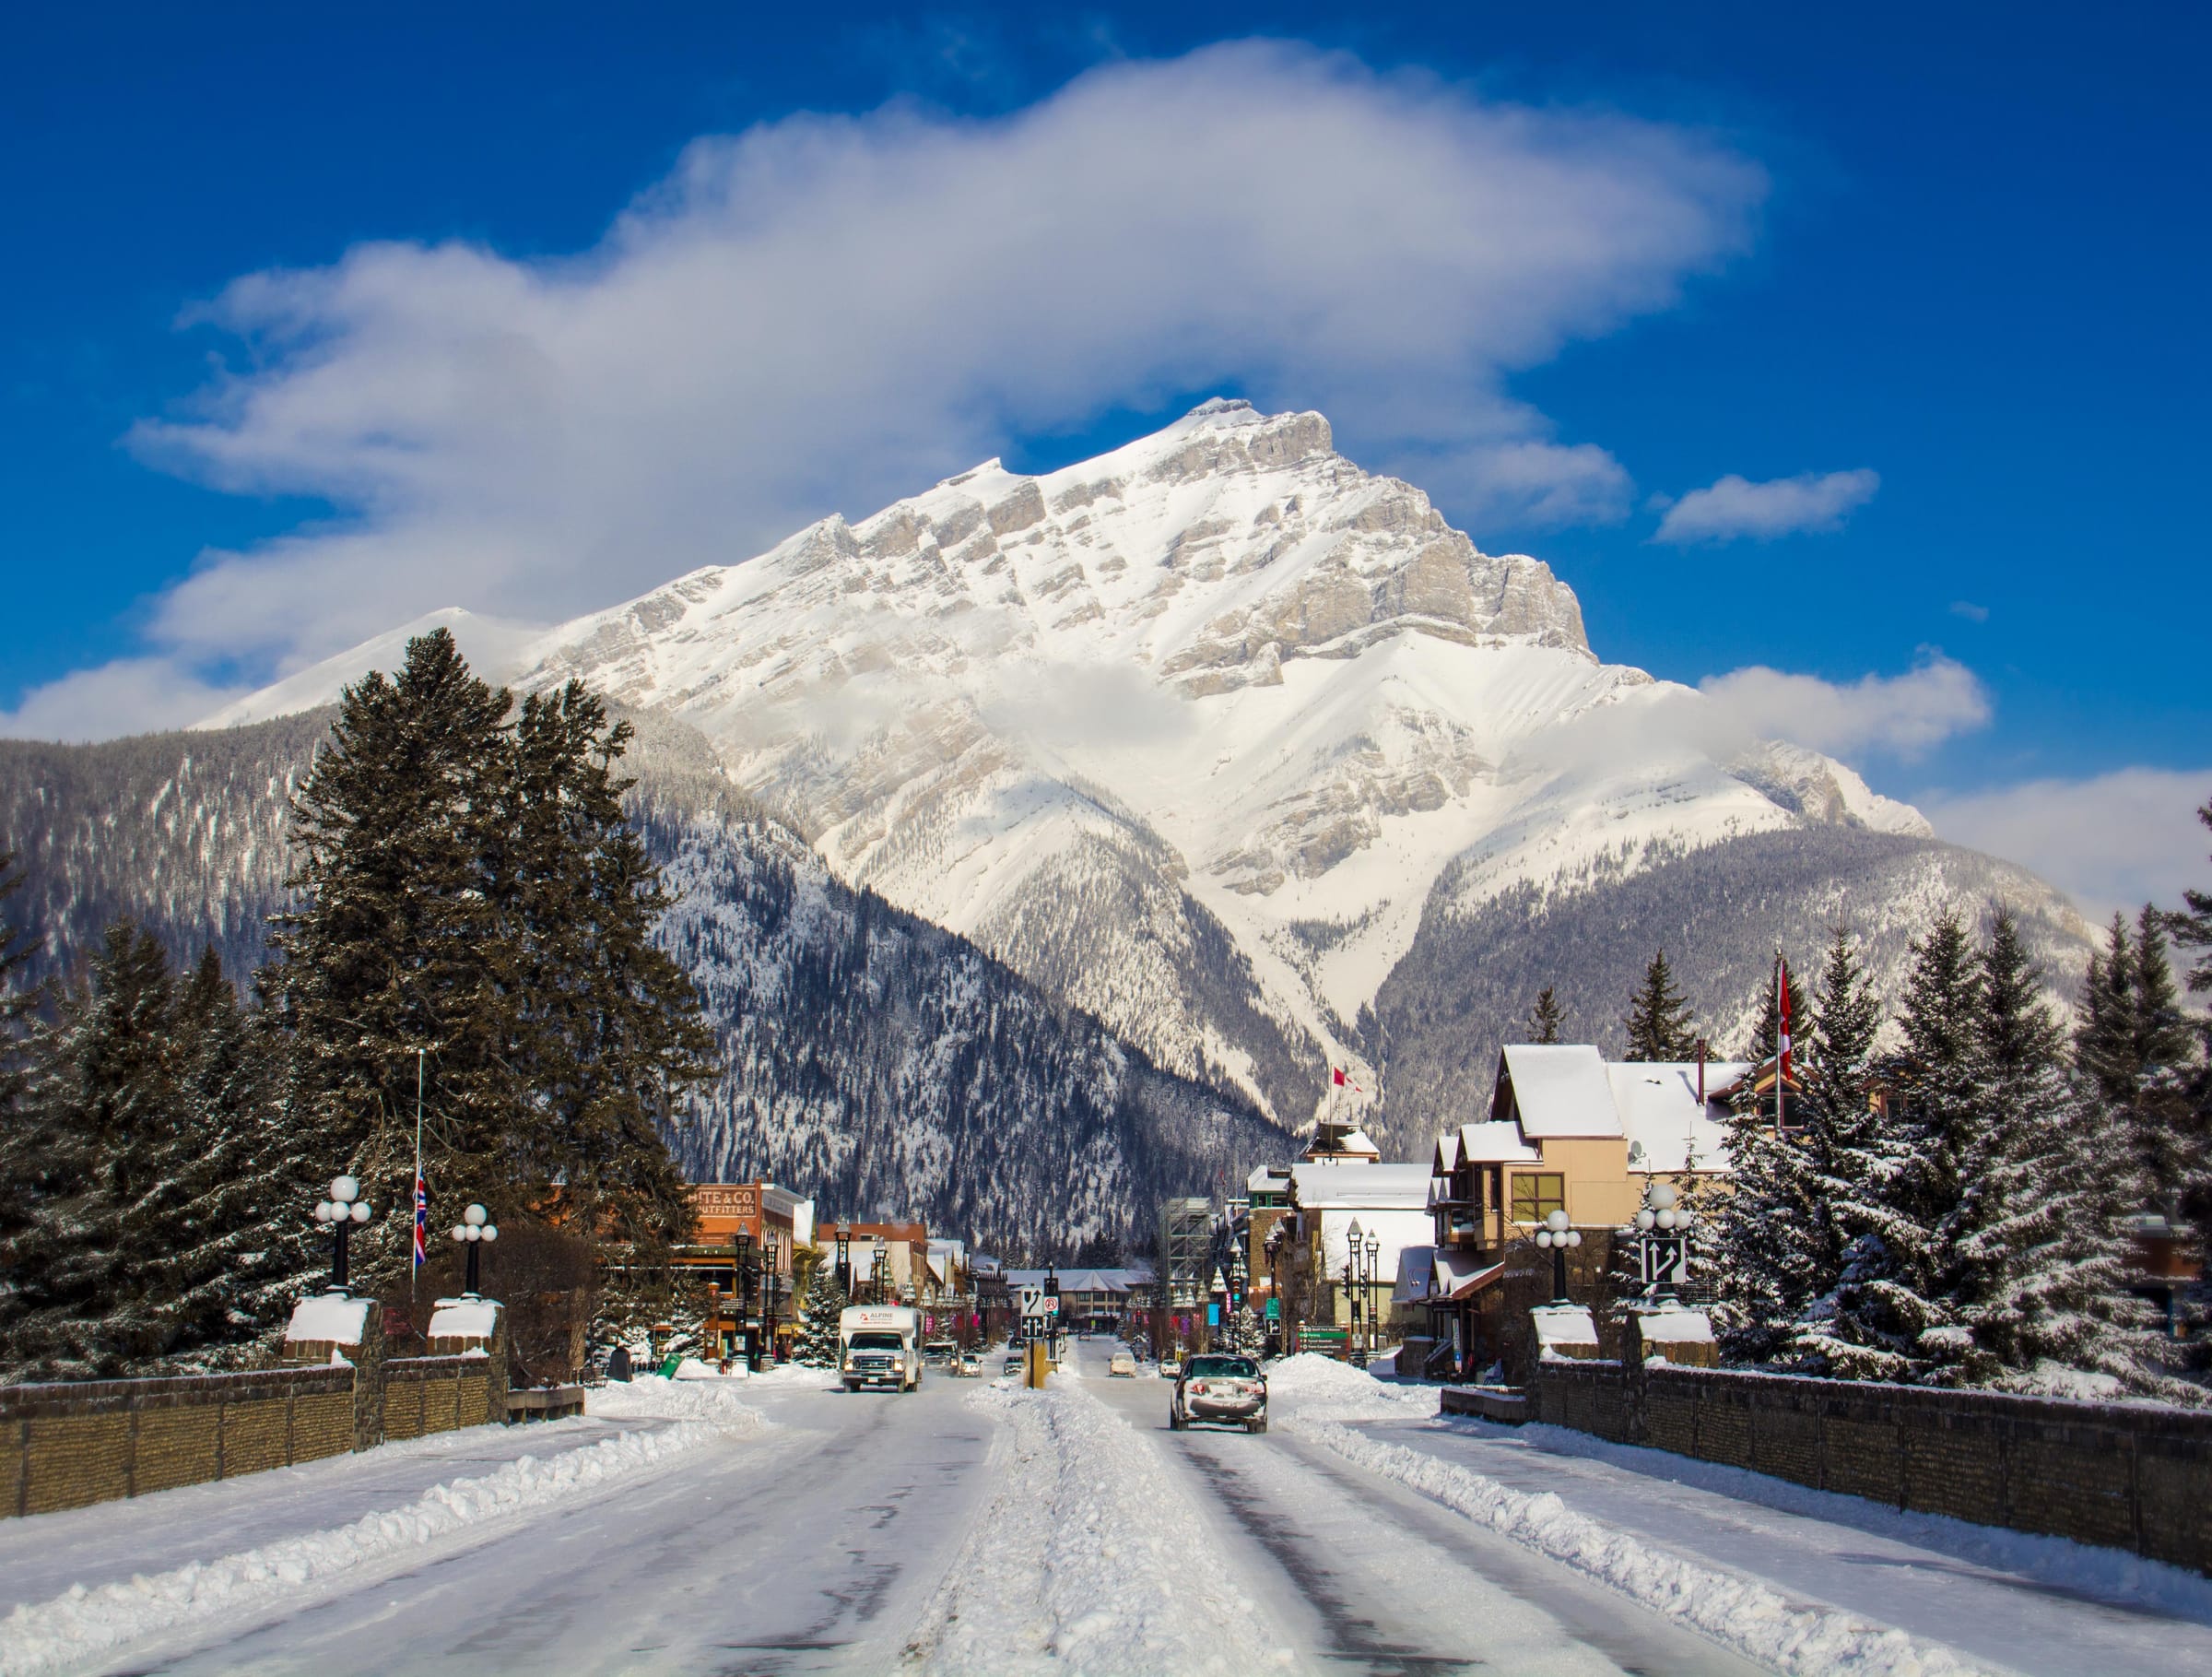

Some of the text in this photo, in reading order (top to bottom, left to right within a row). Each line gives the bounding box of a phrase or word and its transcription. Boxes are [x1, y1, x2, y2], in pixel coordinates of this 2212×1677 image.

[682, 1191, 754, 1204] HITE & CO.
